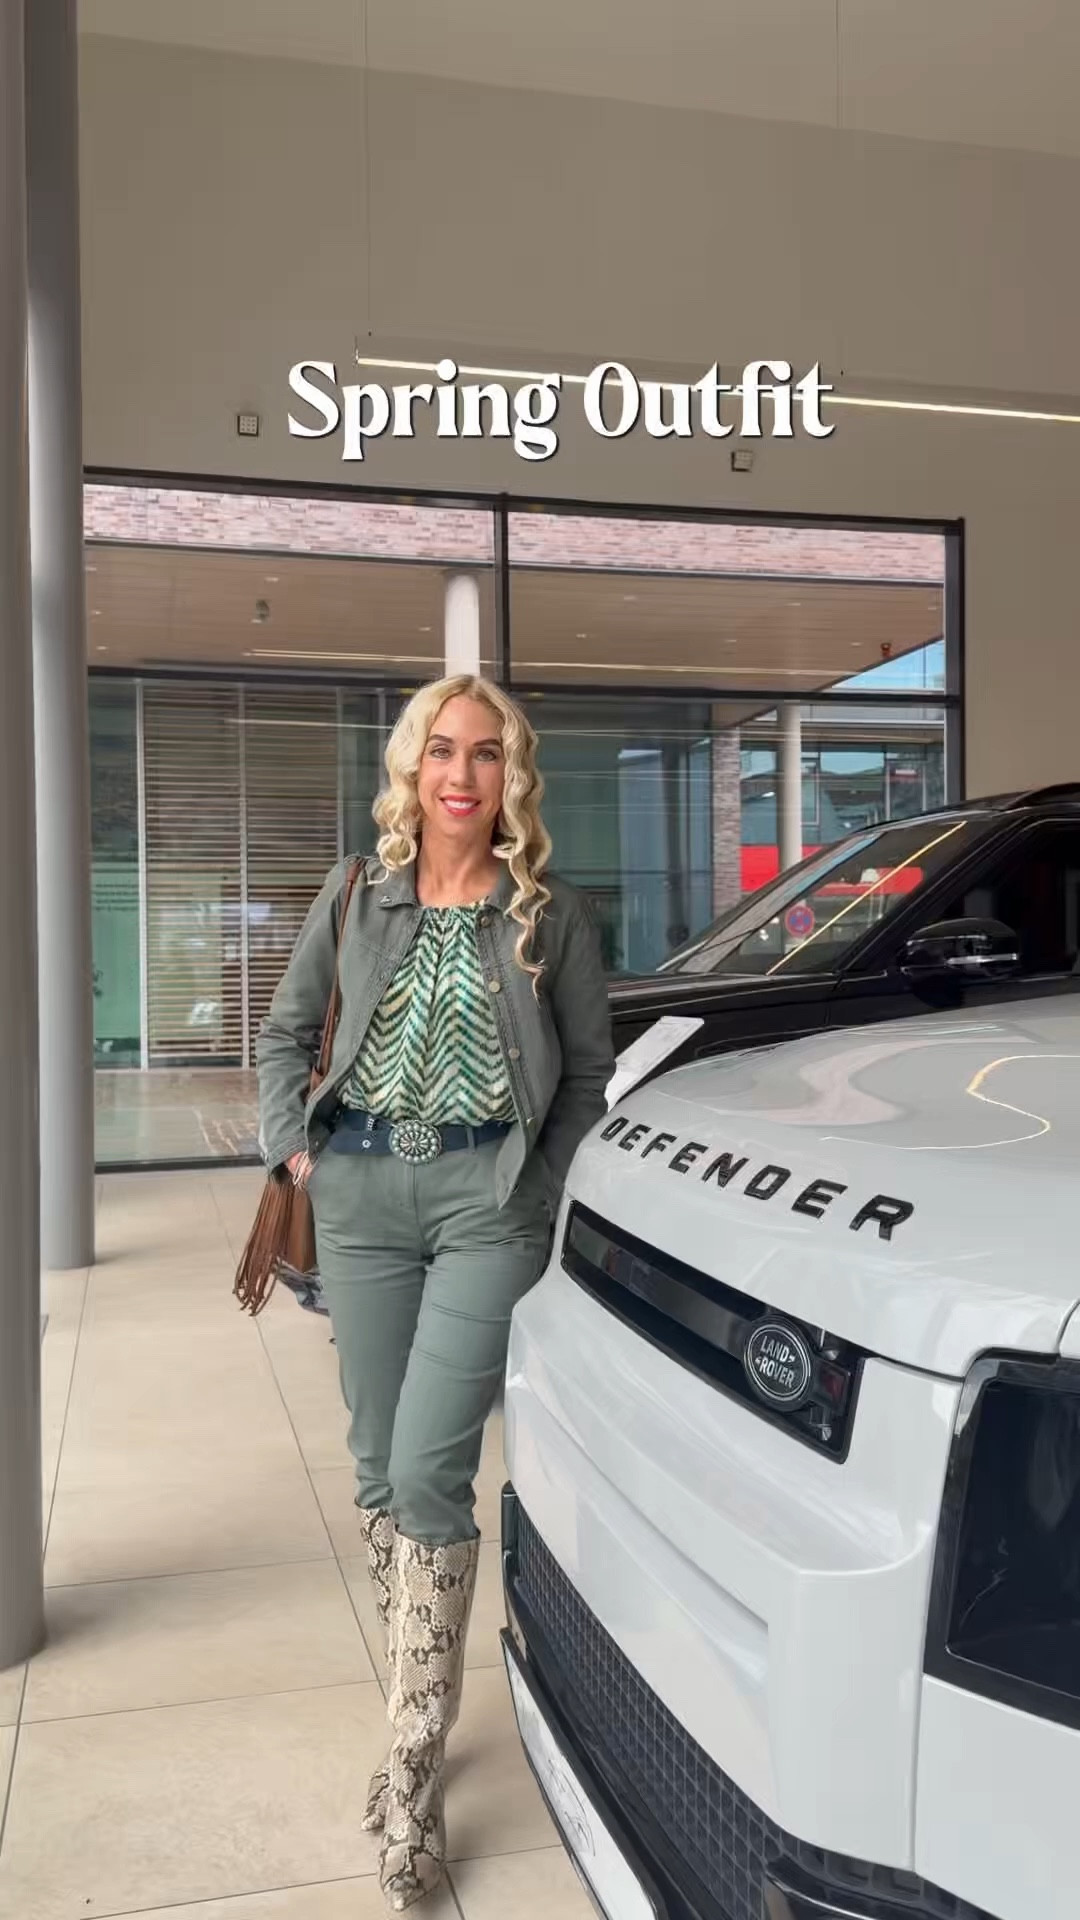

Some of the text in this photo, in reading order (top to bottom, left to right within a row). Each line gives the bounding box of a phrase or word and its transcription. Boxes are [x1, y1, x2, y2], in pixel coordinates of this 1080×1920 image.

[600, 1116, 914, 1241] DEFENDER
[761, 1335, 790, 1363] LAND
[760, 1357, 795, 1388] ROVER
